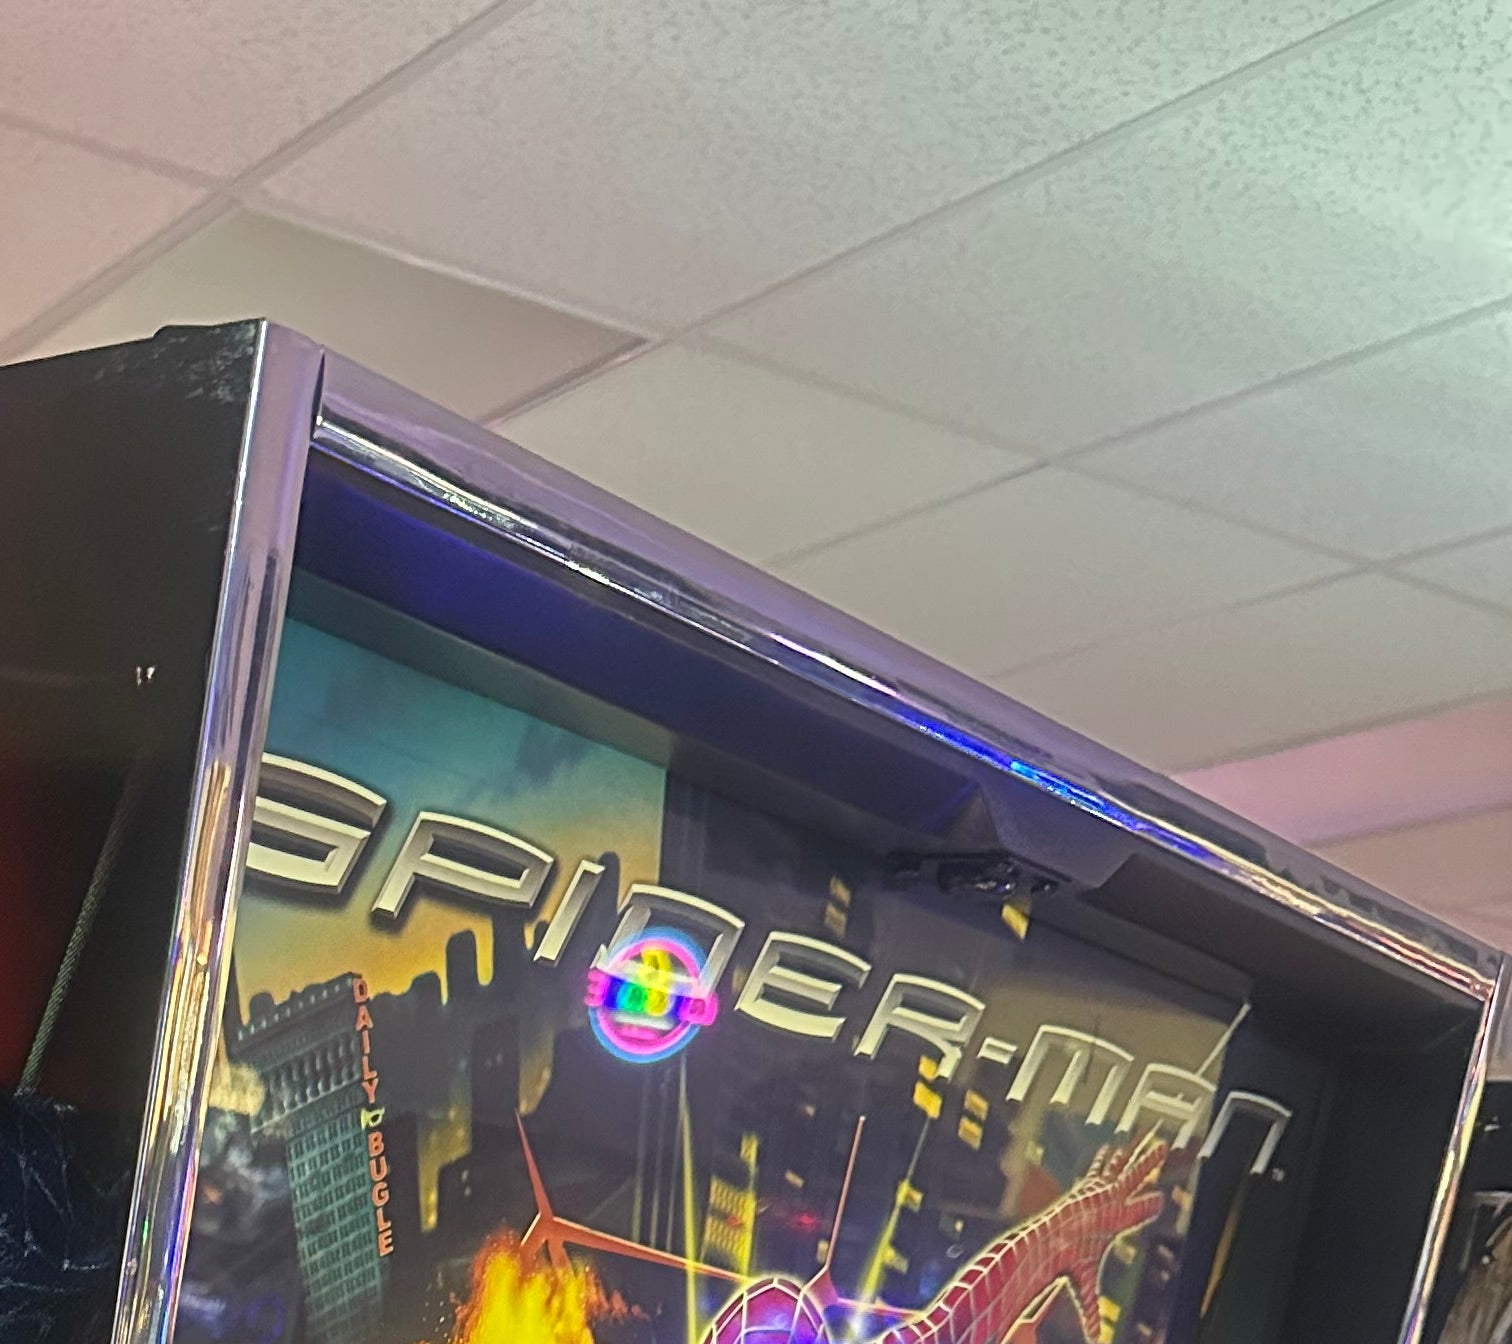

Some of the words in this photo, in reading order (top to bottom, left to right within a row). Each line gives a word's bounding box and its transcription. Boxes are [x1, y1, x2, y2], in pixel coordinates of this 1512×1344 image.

[245, 752, 1293, 1175] SPIDER-MAN
[353, 978, 379, 1103] DAILY
[368, 1130, 394, 1257] BUGLE
